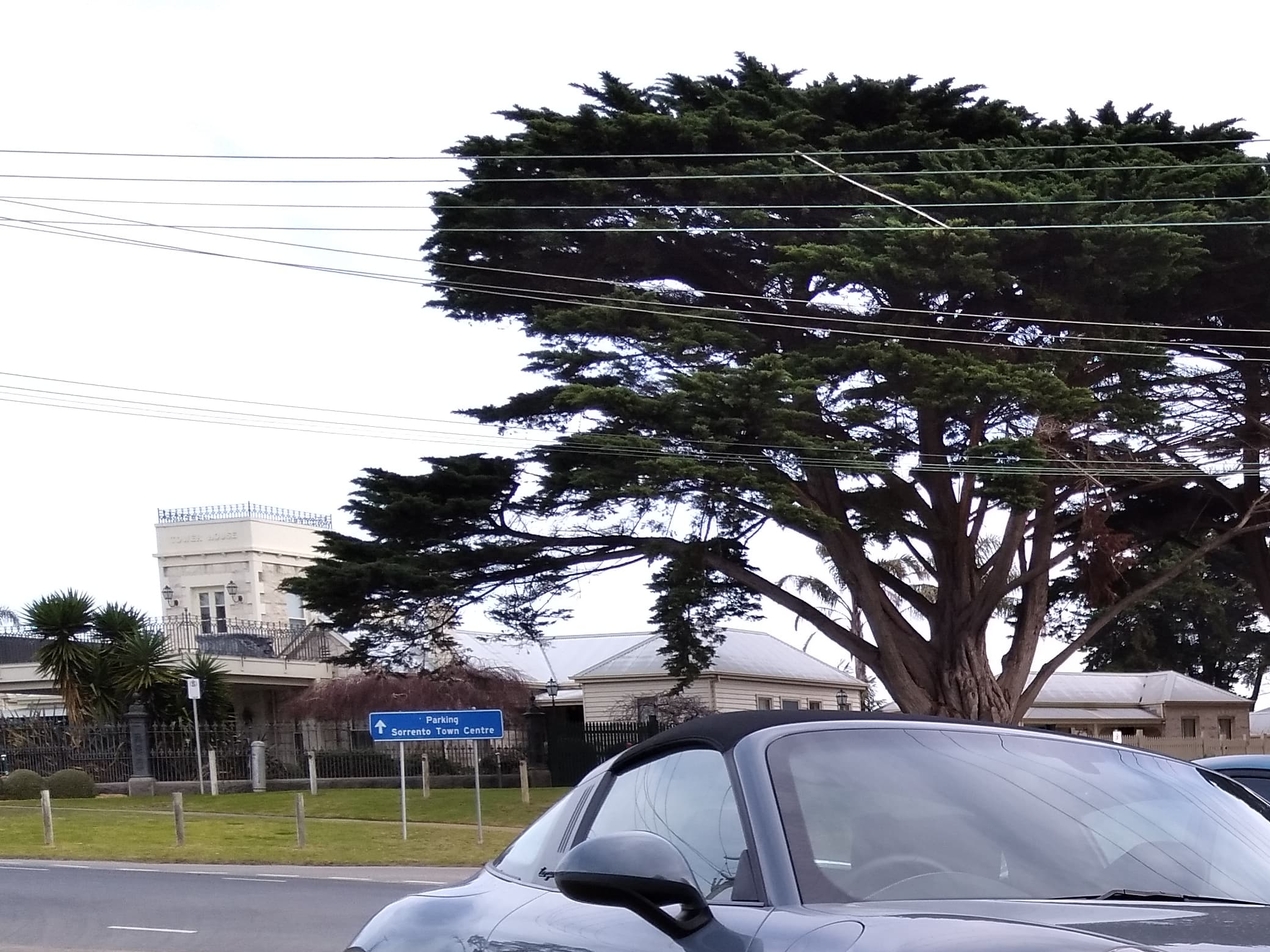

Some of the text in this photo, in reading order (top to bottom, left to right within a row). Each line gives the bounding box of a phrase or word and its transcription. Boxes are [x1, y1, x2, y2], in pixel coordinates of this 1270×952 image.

[426, 716, 459, 725] Parking
[391, 726, 495, 736] Sorrento Town Centre
